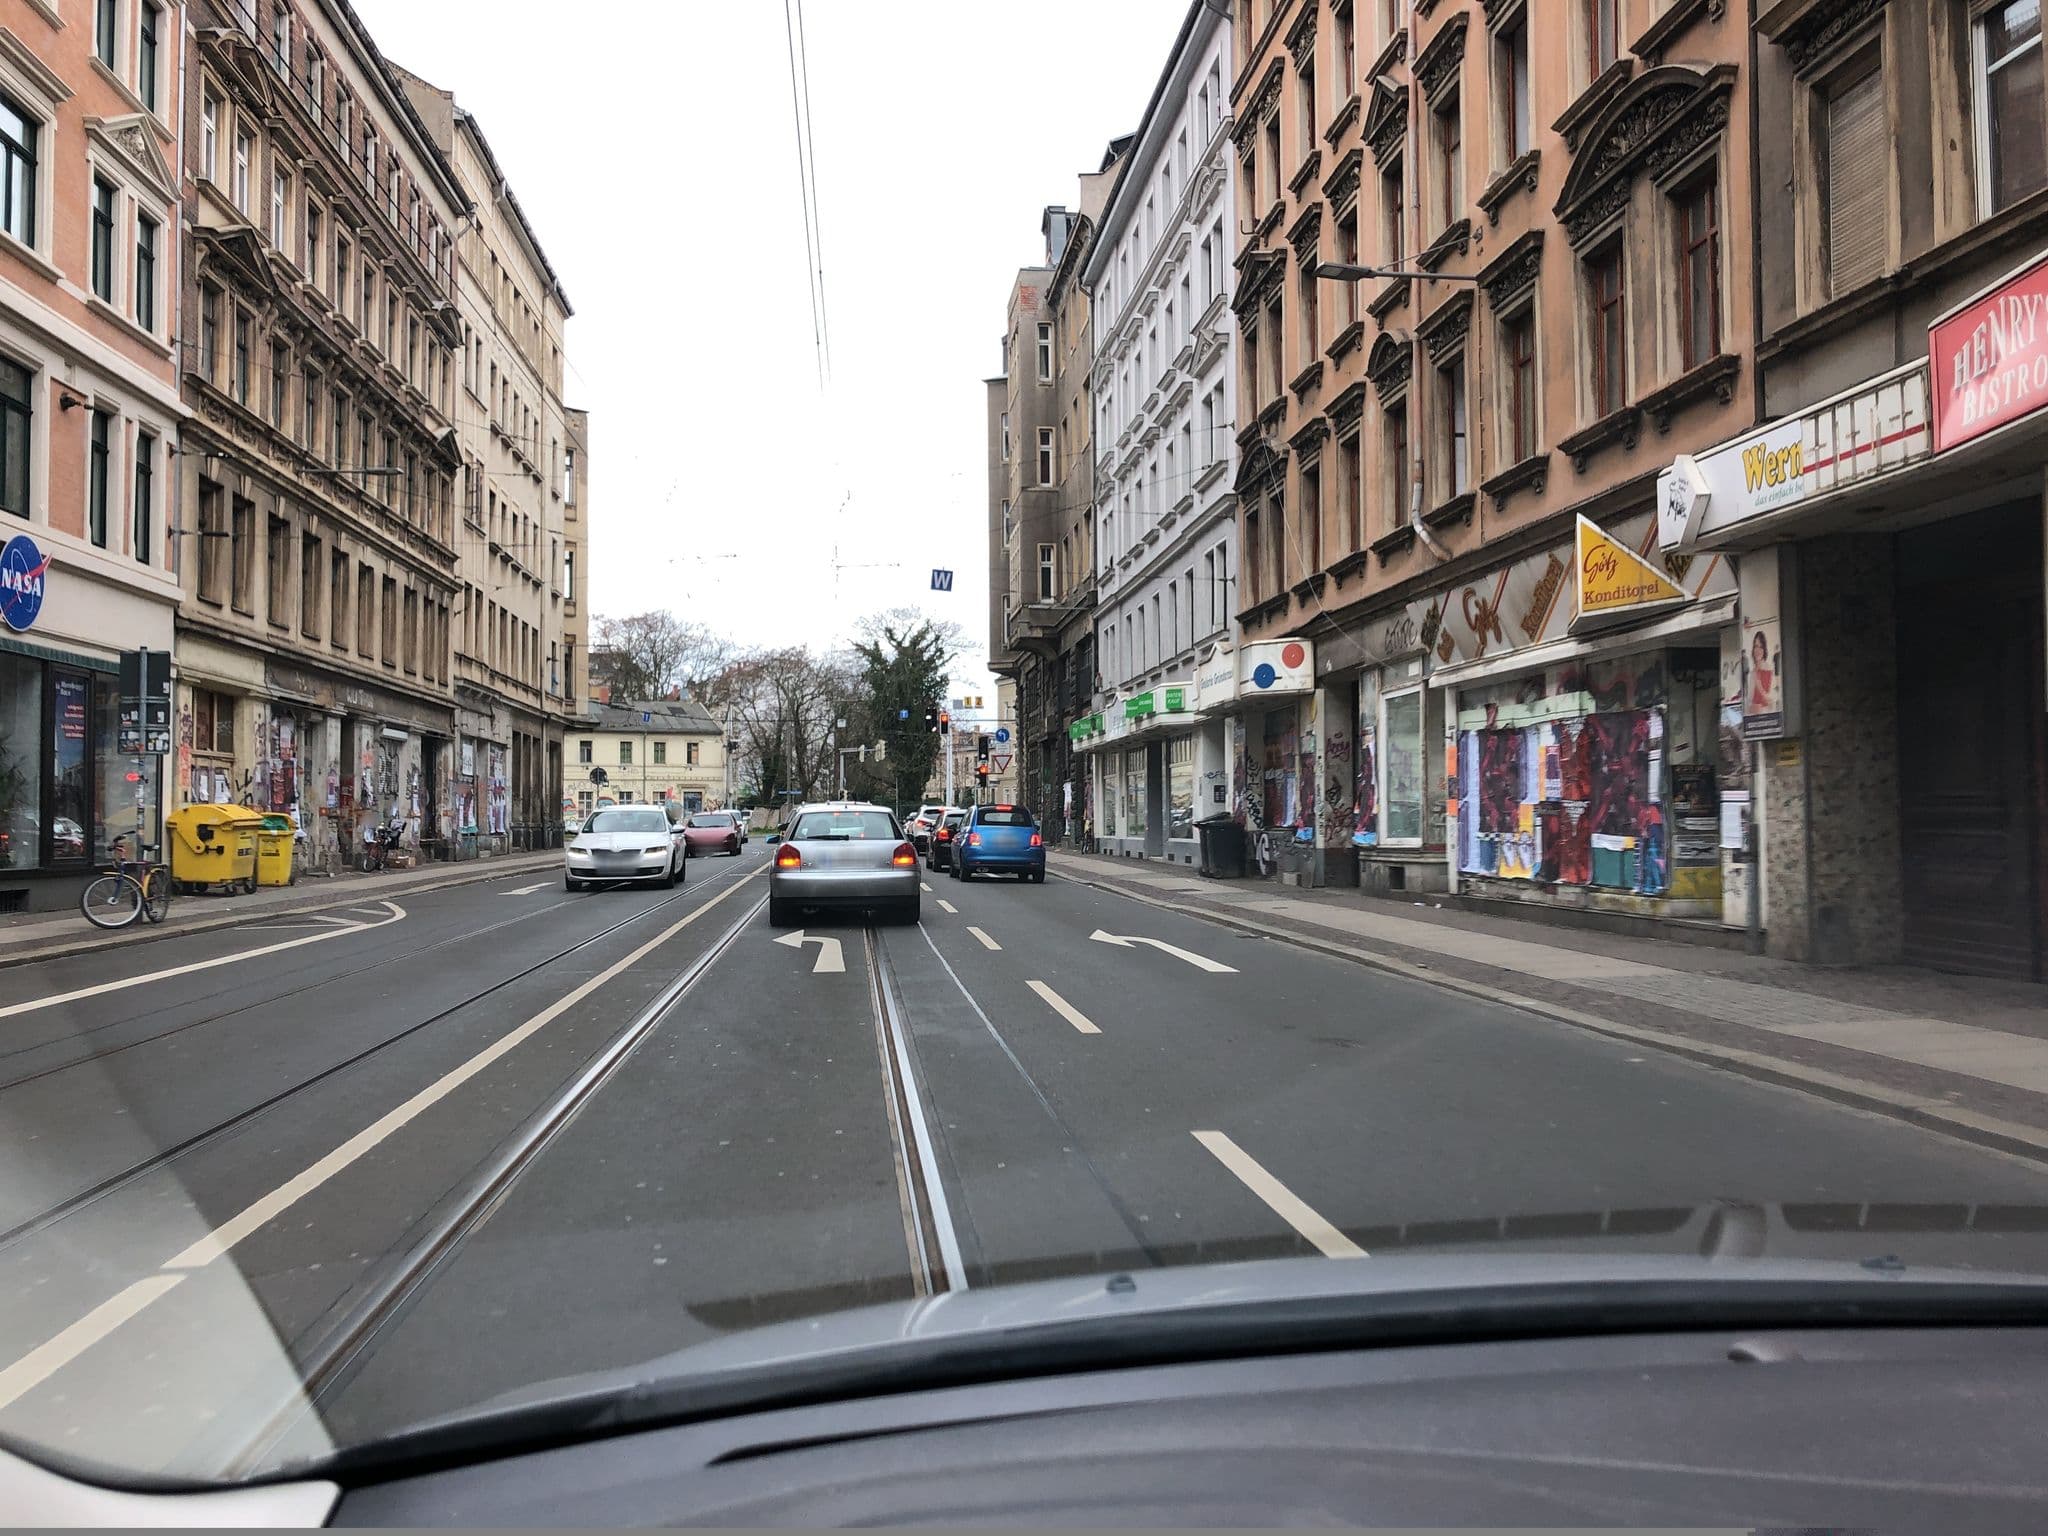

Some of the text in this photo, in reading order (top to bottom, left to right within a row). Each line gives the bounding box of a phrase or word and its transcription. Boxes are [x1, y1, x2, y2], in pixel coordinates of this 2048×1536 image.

[1953, 293, 2048, 392] HENRY'
[1962, 354, 2048, 426] BISTRO
[1, 567, 42, 596] NASA
[933, 571, 951, 589] W
[1584, 580, 1659, 605] Konditorei
